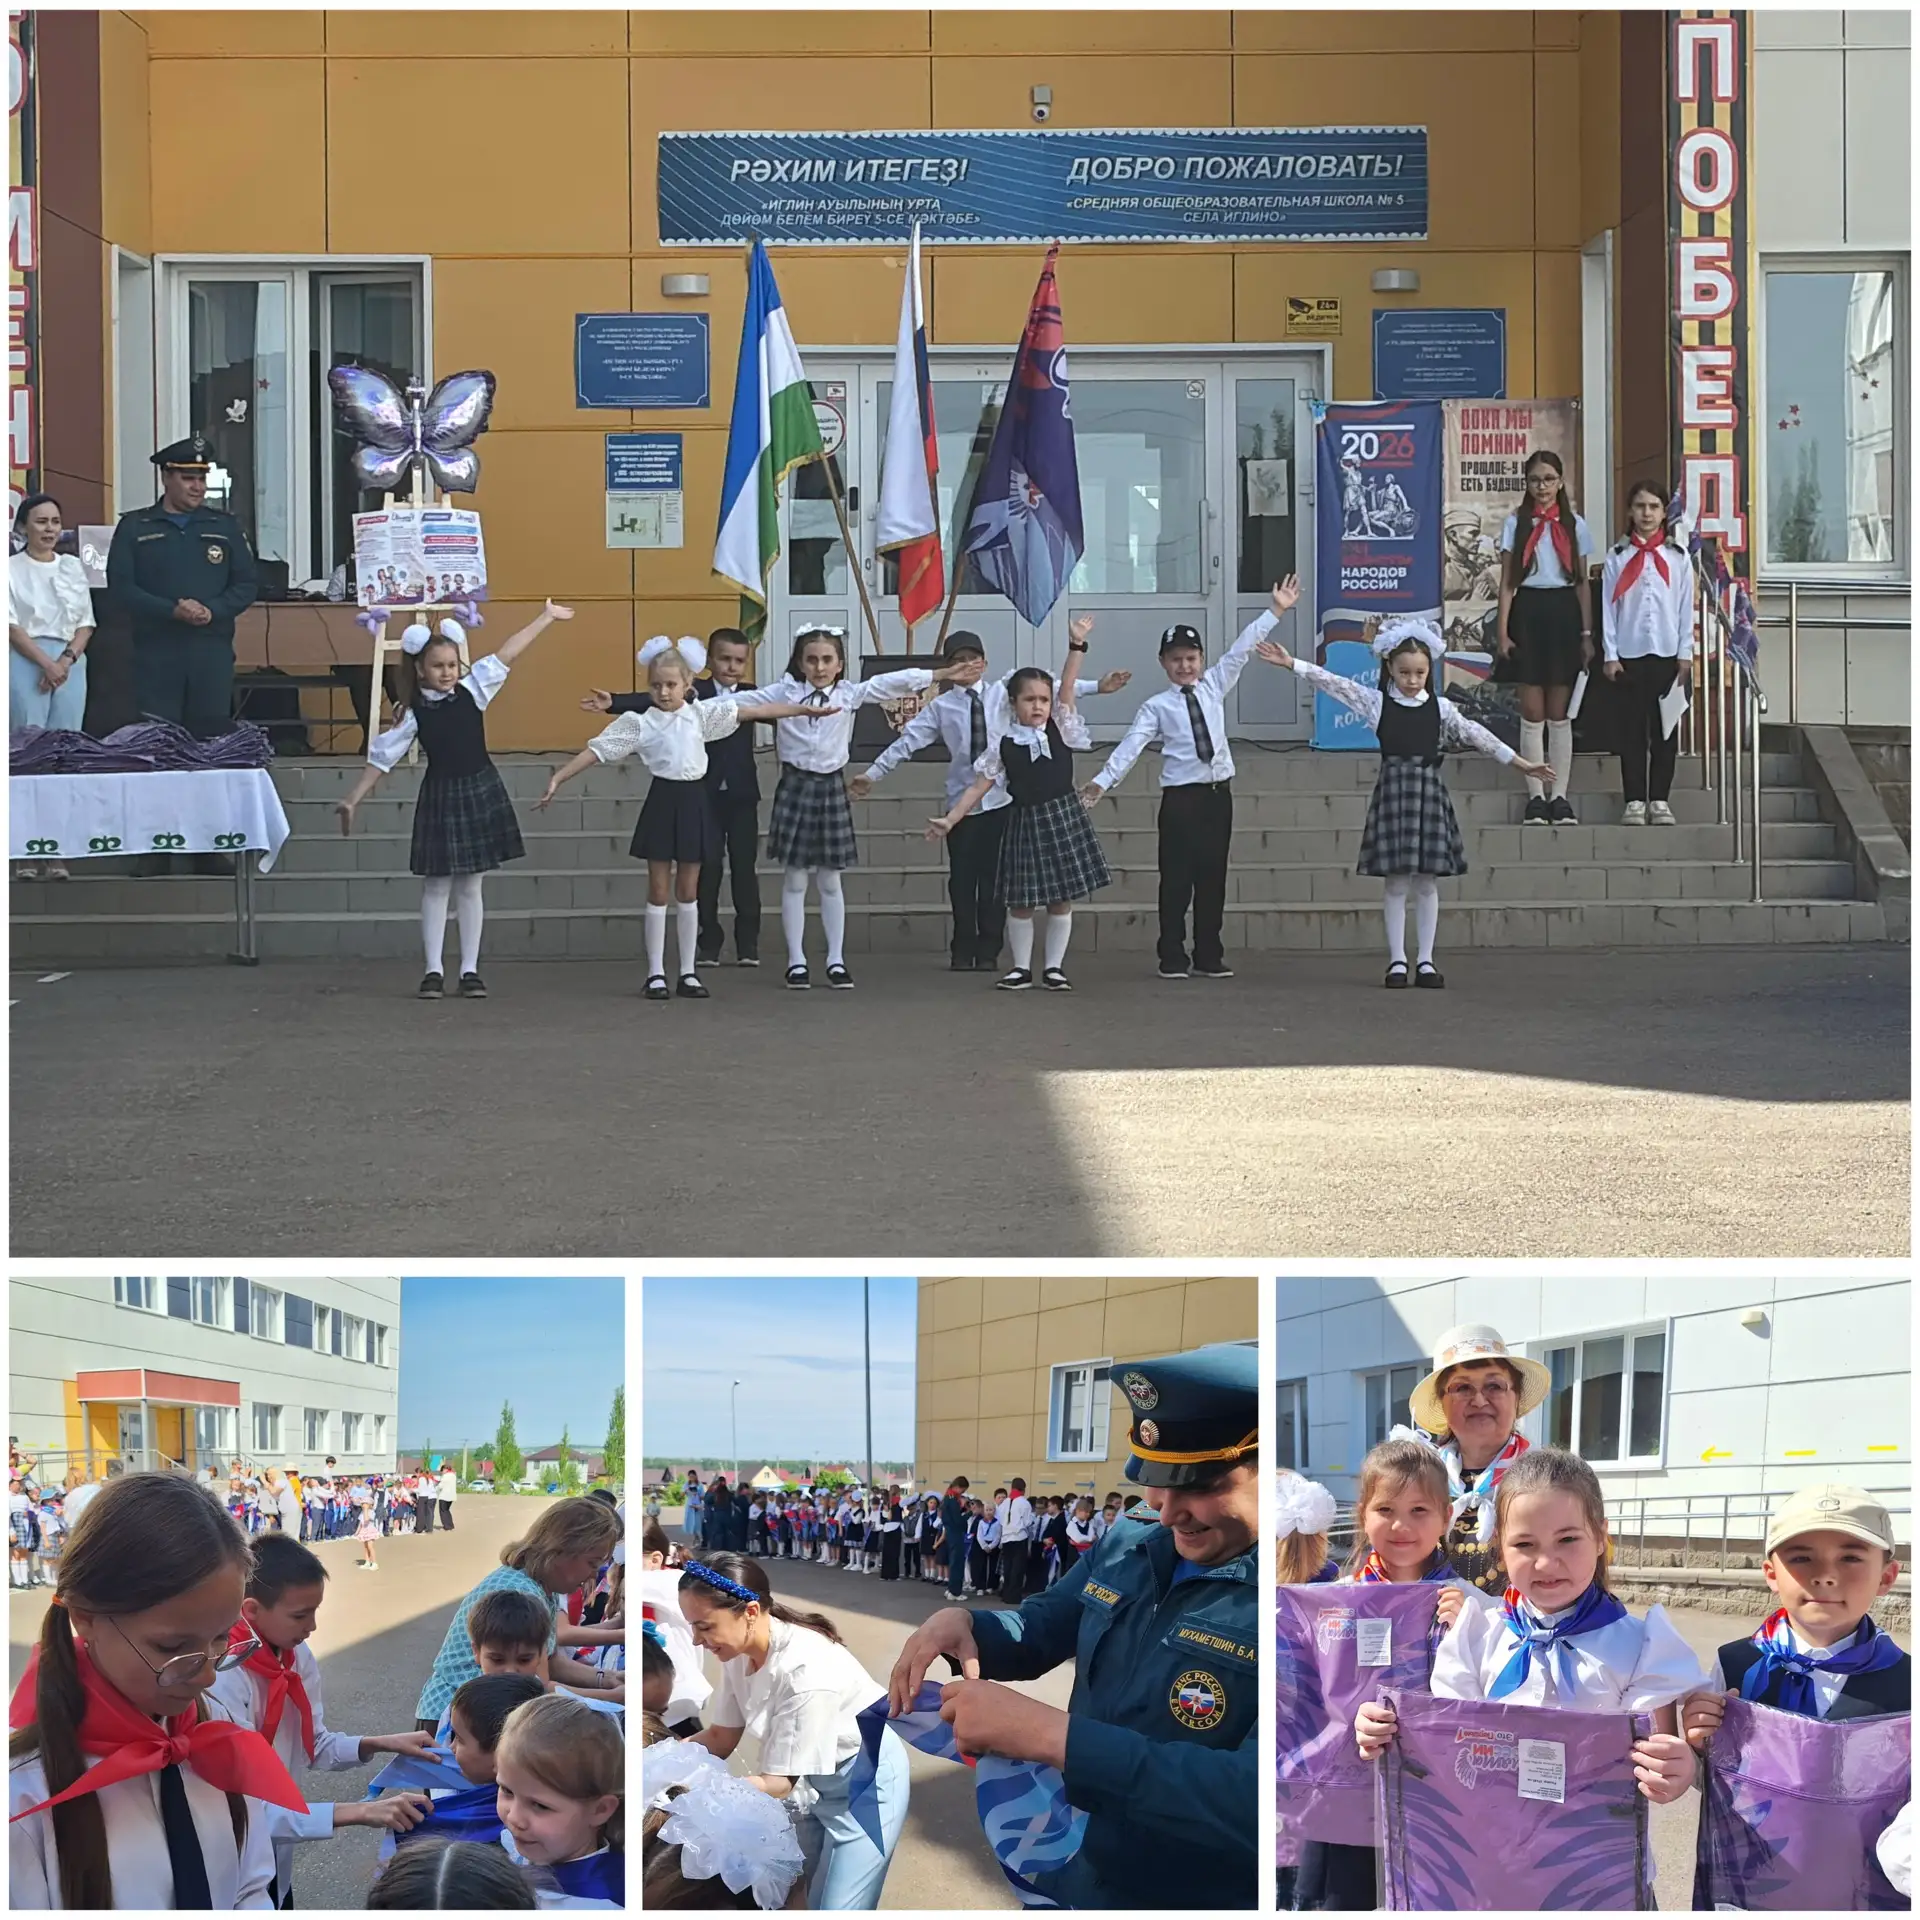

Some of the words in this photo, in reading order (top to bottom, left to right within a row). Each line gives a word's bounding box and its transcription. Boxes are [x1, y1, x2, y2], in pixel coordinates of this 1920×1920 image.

[730, 159, 836, 183] РӘХИМ
[1066, 157, 1176, 186] ДОБРО
[1183, 154, 1405, 179] ПОЖАЛОВАТЬ!
[761, 199, 814, 211] «ИГЛИН
[907, 199, 942, 211] УРТА
[1066, 197, 1140, 210] «СРЕДНЯЯ
[1142, 195, 1322, 209] ОБЩЕОБРАЗОВАТЕЛЬНАЯ
[1323, 194, 1375, 207] ШКОЛА
[1377, 194, 1393, 206] №
[1395, 193, 1405, 206] 5
[1182, 211, 1220, 223] СЕЛА
[1222, 210, 1287, 223] ИГЛИНО»
[1460, 408, 1500, 430] ПОКА
[1505, 407, 1533, 430] МЫ
[1340, 431, 1415, 461] 2026
[1460, 432, 1527, 456] ПОМНИМ
[1460, 477, 1484, 492] ЕСТЬ
[1486, 477, 1527, 493] БУДУЩЕ
[1340, 567, 1408, 579] НАРОДОВ
[1340, 579, 1399, 591] РОССИИ
[1094, 1586, 1121, 1605] РОССИИ
[1178, 1628, 1236, 1654] МУХАМЕТШИН
[1236, 1645, 1257, 1662] Б.А.
[1175, 1672, 1193, 1692] МЧС
[1194, 1672, 1224, 1705] РОССИИ
[1171, 1698, 1223, 1728] EMERCOM
